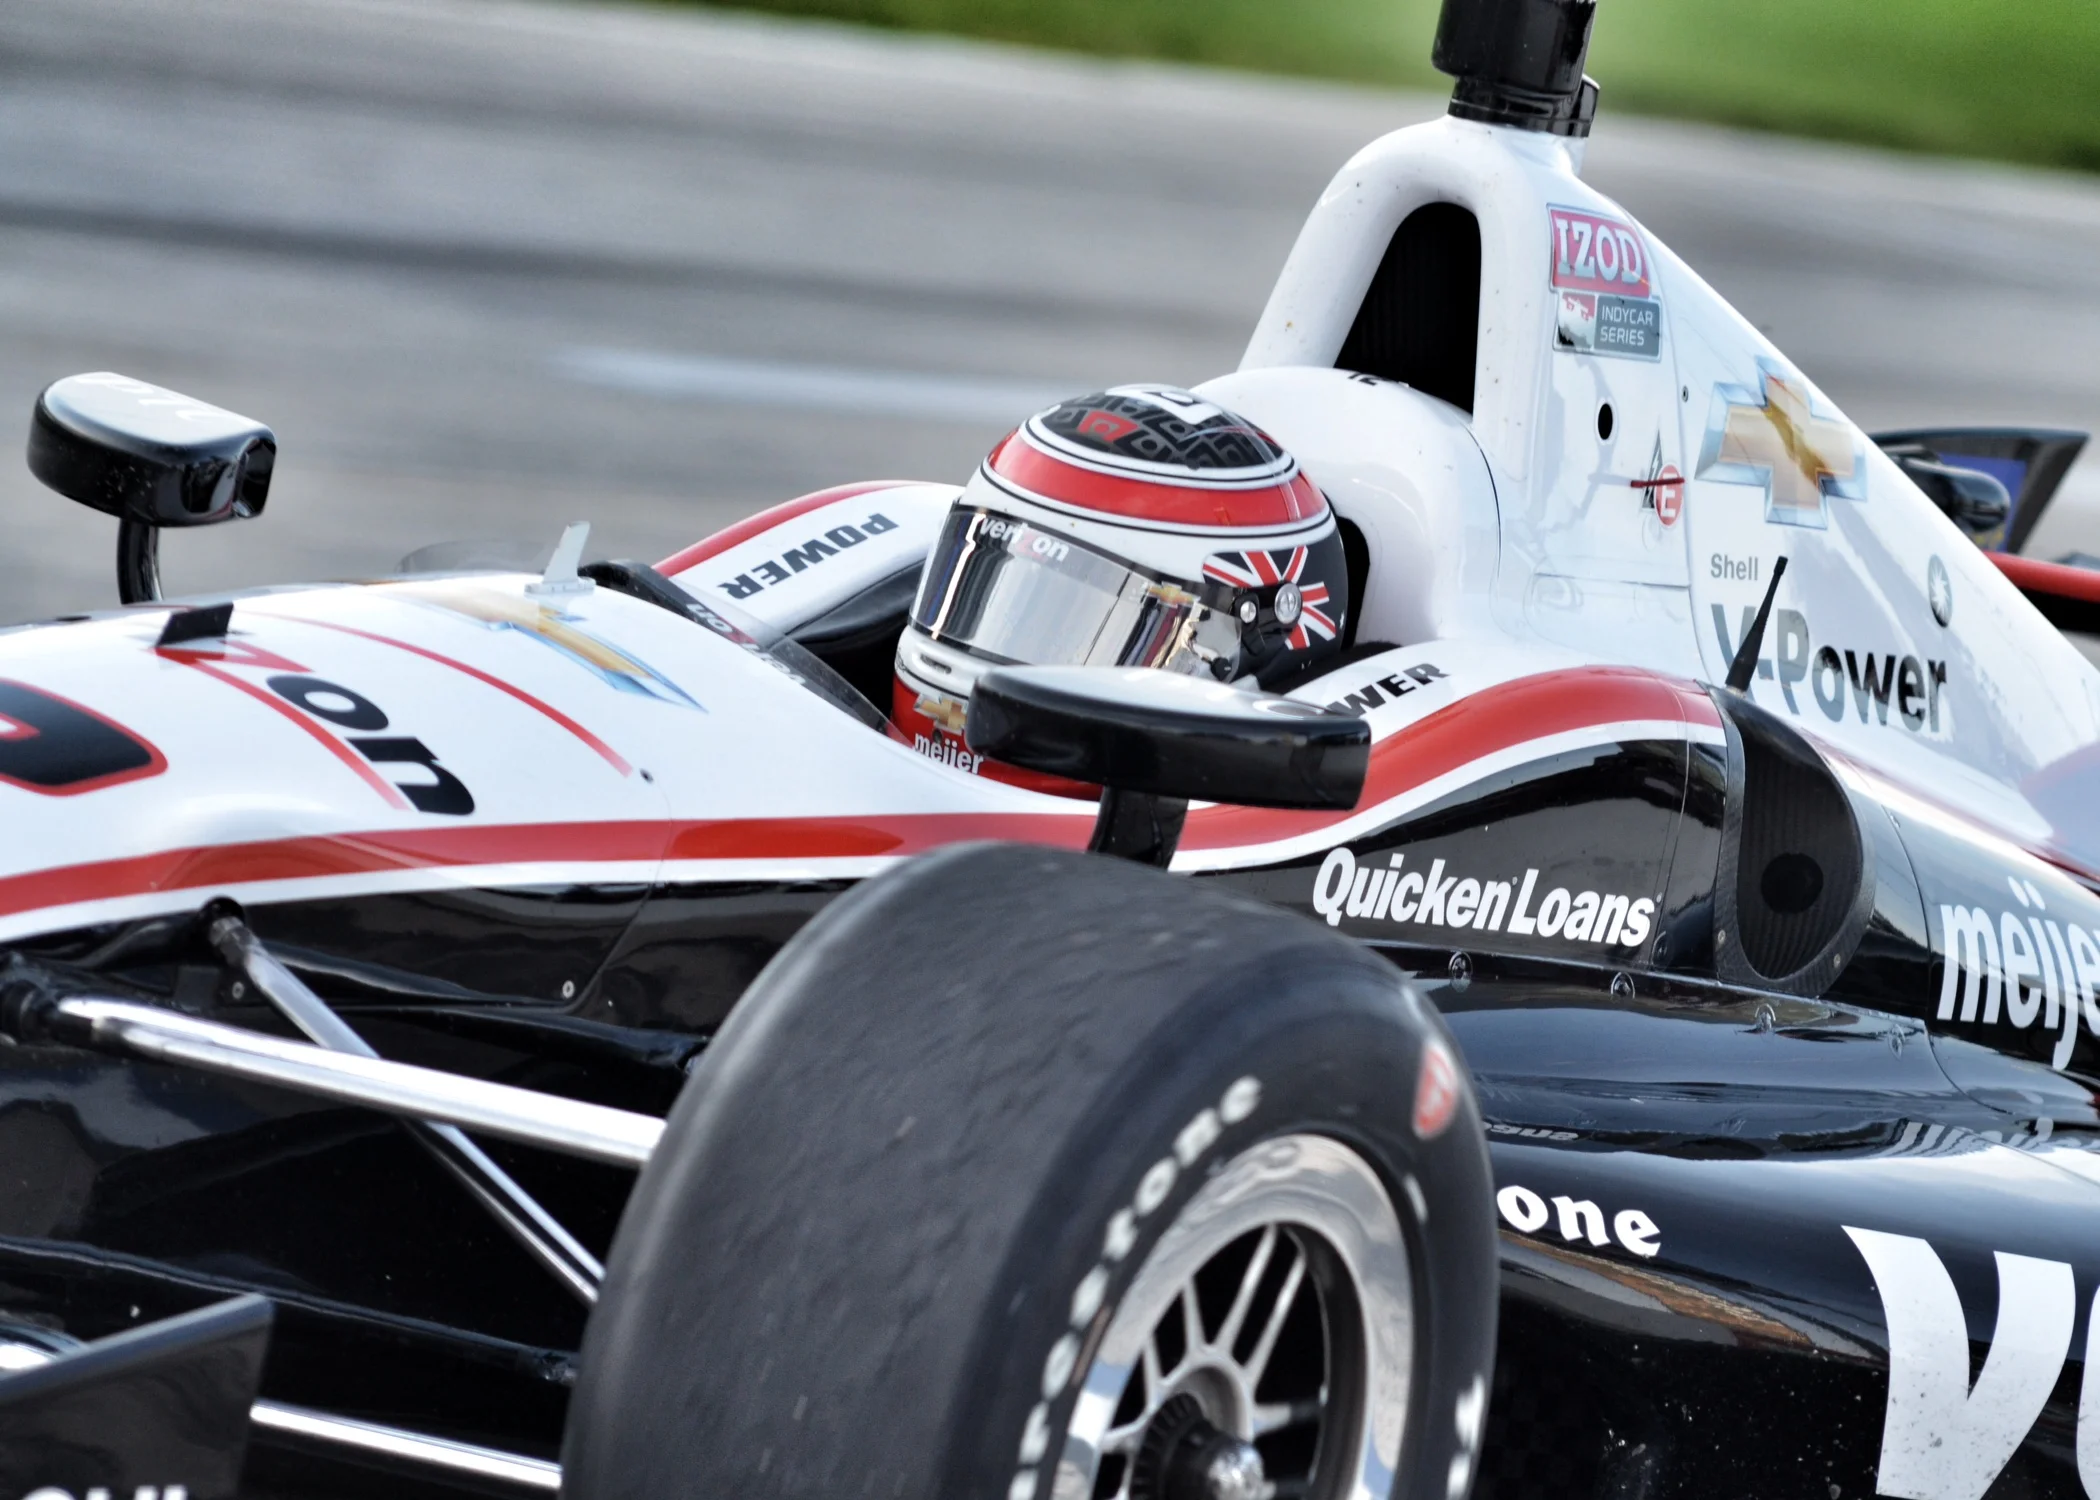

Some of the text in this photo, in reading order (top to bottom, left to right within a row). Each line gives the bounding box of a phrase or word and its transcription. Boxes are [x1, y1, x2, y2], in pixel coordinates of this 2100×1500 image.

[1554, 217, 1642, 284] IZOD
[1599, 326, 1645, 347] SERIES
[1601, 304, 1655, 327] INDYCAR
[717, 513, 900, 600] POWER
[980, 516, 1071, 563] verizon
[1710, 553, 1759, 581] Shell
[1937, 876, 2100, 1071] meije
